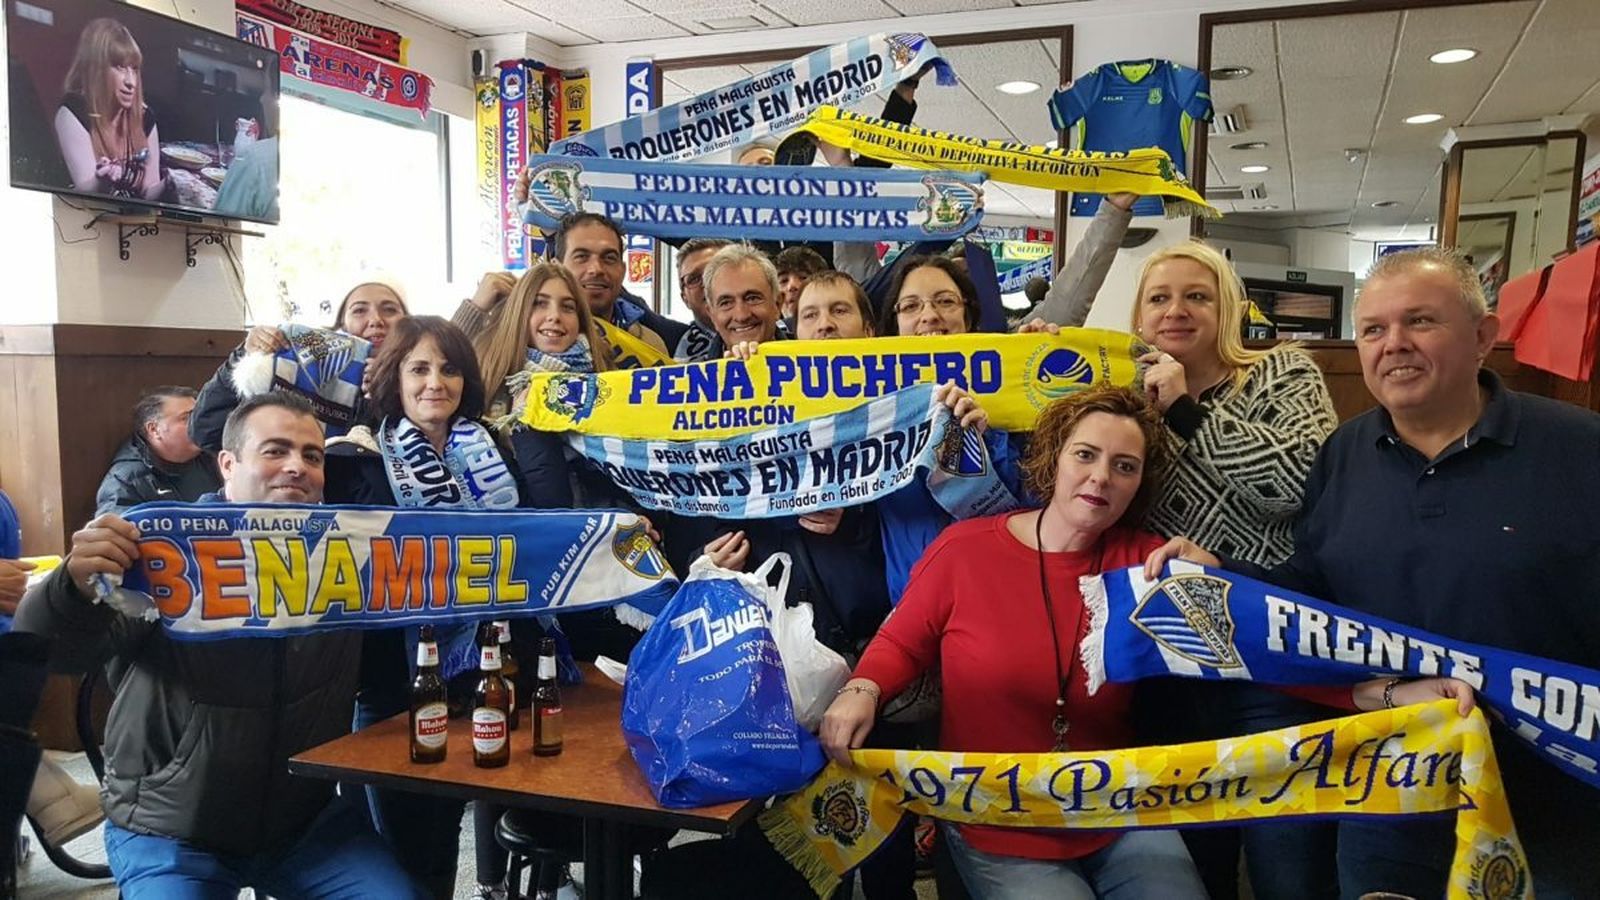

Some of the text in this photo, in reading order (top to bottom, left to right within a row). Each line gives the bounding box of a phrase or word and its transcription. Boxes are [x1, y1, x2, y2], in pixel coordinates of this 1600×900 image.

[325, 11, 376, 40] SEGONA
[281, 44, 394, 90] ARENAS
[718, 67, 796, 106] MALAGUISTA
[759, 90, 790, 121] EN
[795, 53, 883, 108] MADRID
[506, 107, 520, 180] PETACAS
[940, 146, 1018, 170] DEPORTIVA
[634, 171, 878, 198] FEDERACIÓN DE
[603, 199, 909, 229] PEÑAS MALAGUISTAS
[766, 349, 1003, 400] PUCHERO
[672, 401, 796, 430] ALCORCÓN
[700, 430, 813, 464] MALAGUISTA
[389, 455, 410, 481] Abril
[757, 456, 800, 495] EN
[399, 483, 414, 499] de
[685, 500, 730, 513] distancia
[769, 492, 817, 511] Fundada
[821, 491, 835, 501] en
[840, 485, 869, 501] Abril
[872, 480, 886, 492] de
[130, 514, 341, 533] CIO PEÑA MALAGUISTA
[540, 516, 598, 600] PUB KIM BAR
[138, 535, 528, 621] BENAMIEL
[1265, 595, 1486, 690] FRENTE
[1049, 758, 1252, 813] Pasión
